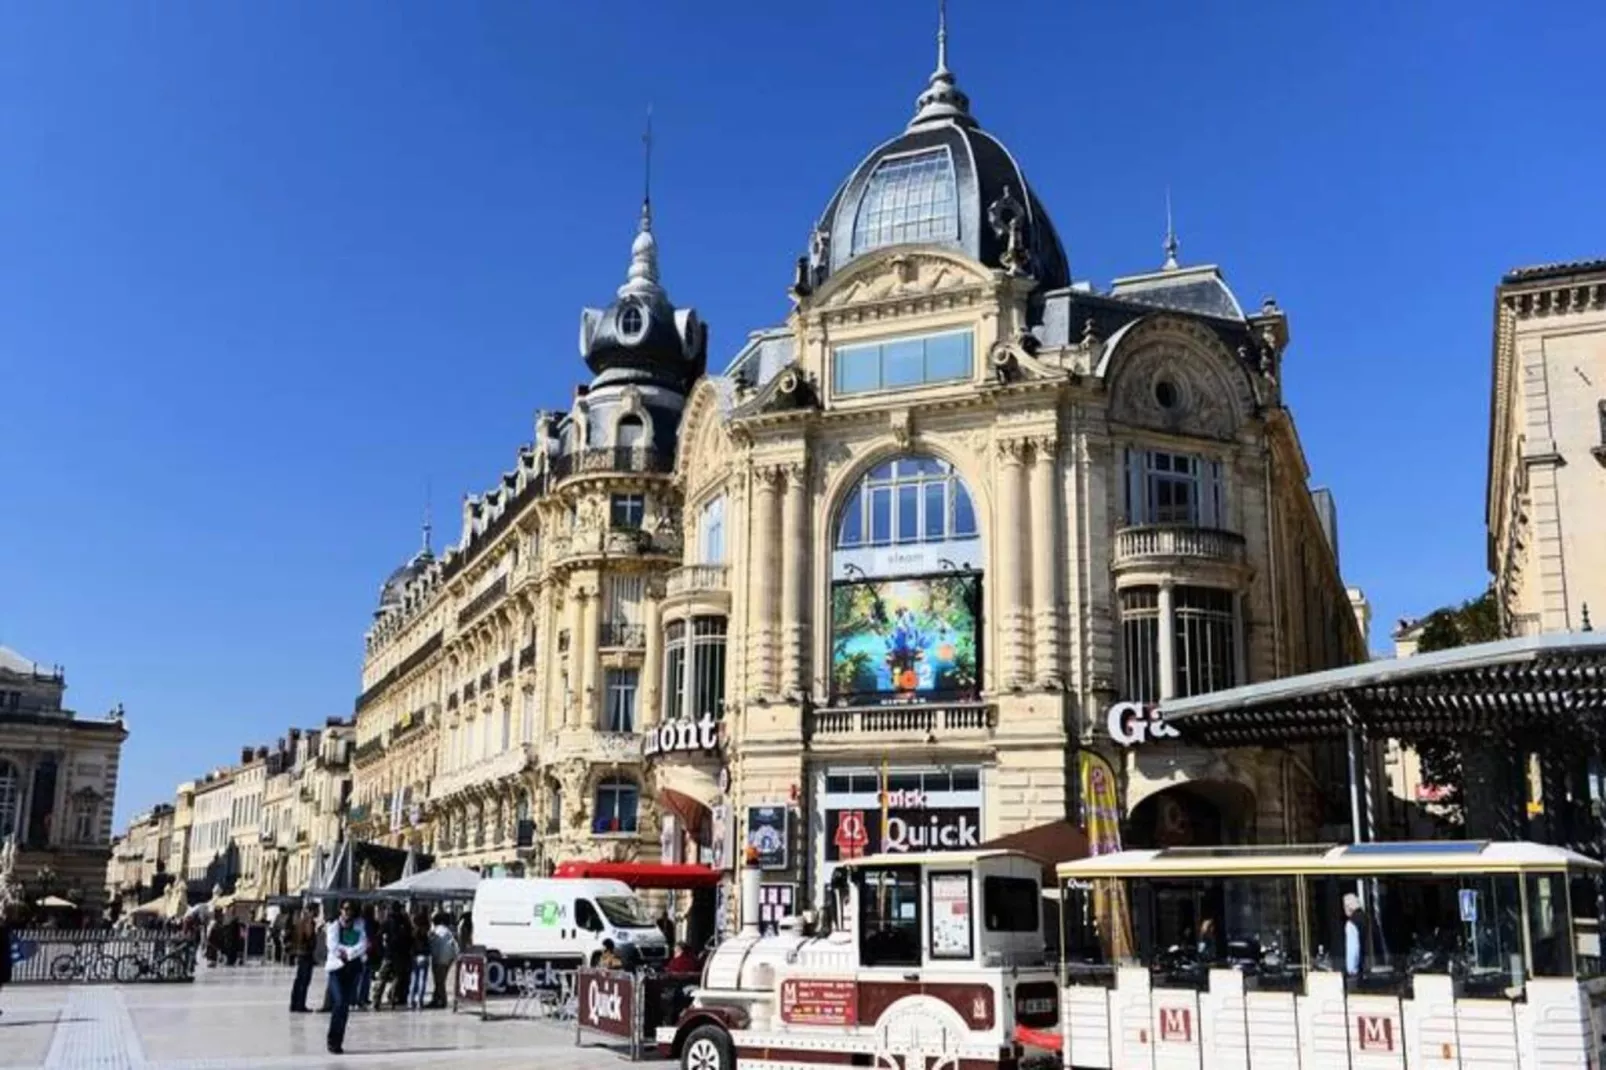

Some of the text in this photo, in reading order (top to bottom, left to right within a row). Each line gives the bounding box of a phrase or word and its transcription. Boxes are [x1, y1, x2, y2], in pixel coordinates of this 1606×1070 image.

[886, 815, 978, 852] Quick
[459, 963, 479, 997] Quick
[487, 961, 560, 991] Quick
[589, 979, 622, 1025] Quick
